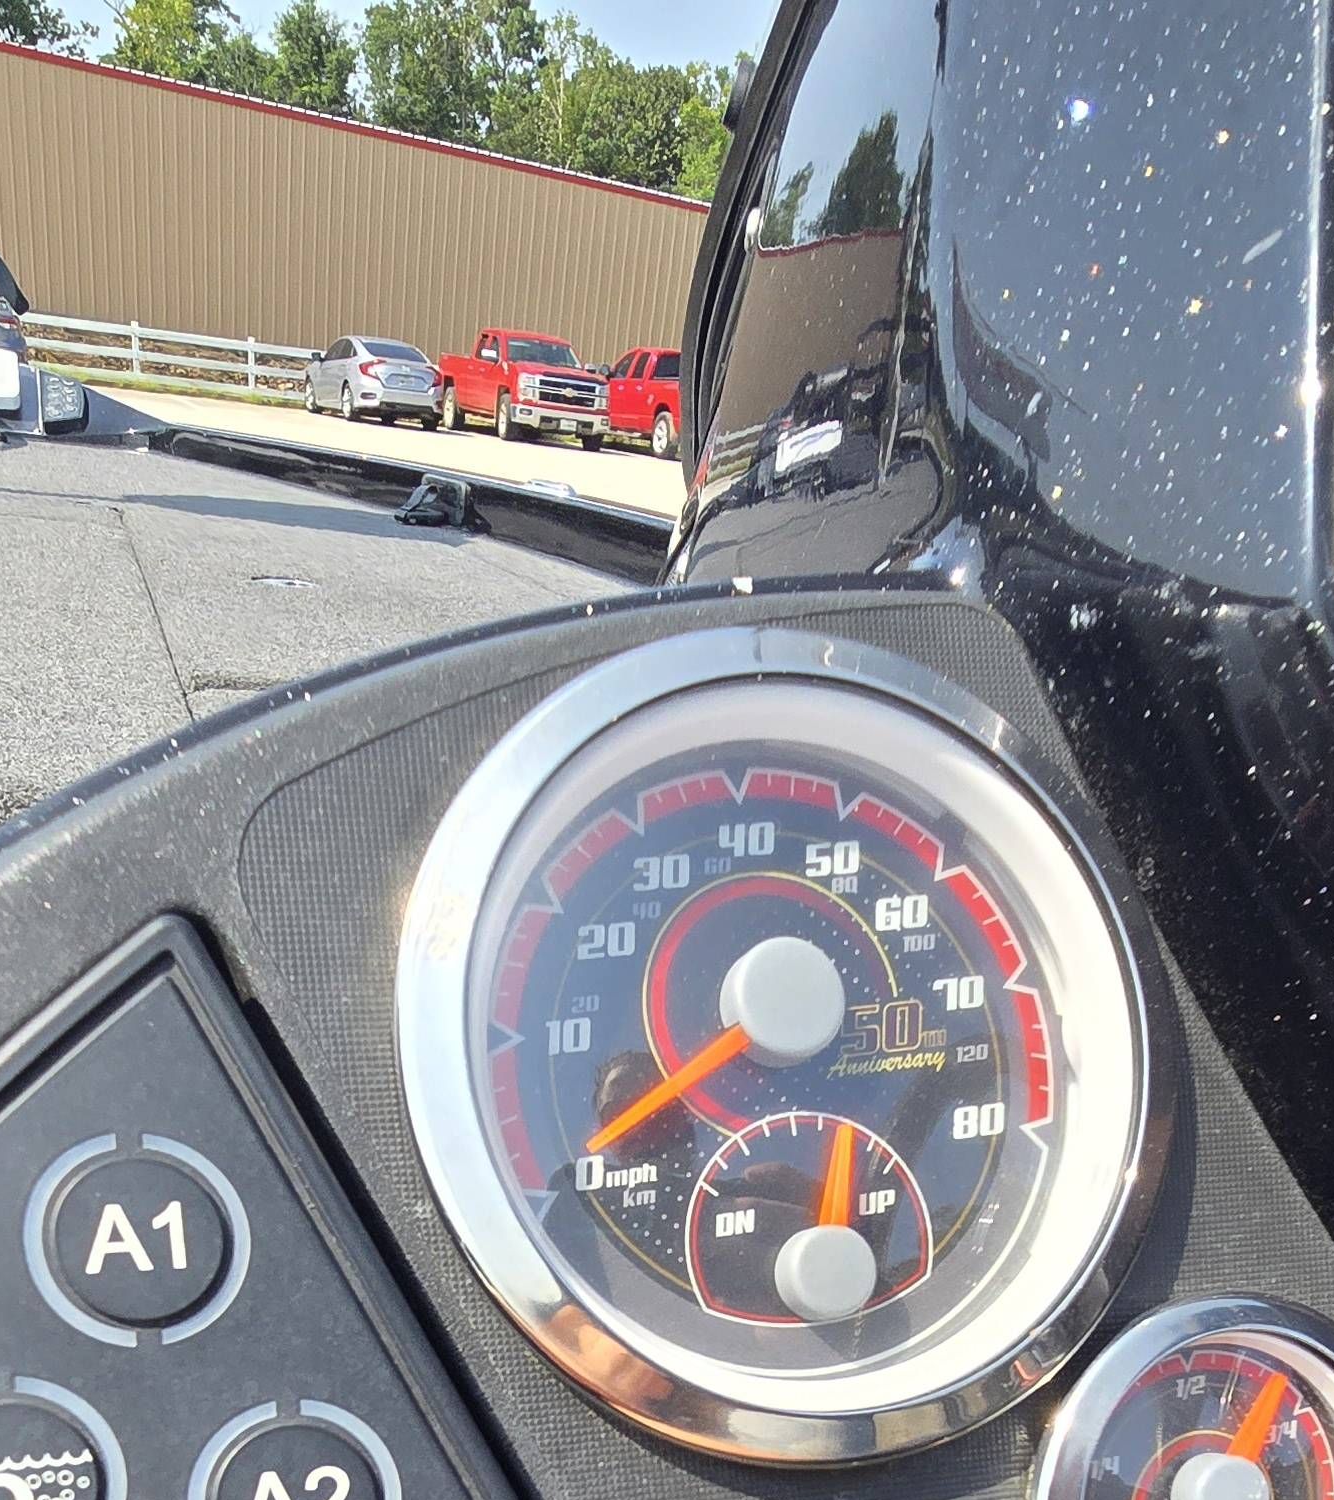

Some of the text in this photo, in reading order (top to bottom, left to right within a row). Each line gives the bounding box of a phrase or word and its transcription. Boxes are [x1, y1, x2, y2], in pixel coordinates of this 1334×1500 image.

[718, 821, 775, 857] 40
[633, 854, 689, 891] 30
[703, 856, 731, 874] 60
[805, 840, 860, 877] 50
[831, 876, 858, 894] 80
[632, 901, 661, 919] 40
[874, 894, 928, 932] 60
[577, 922, 635, 960] 20
[902, 934, 935, 952] 100
[572, 995, 600, 1014] 20
[932, 976, 985, 1011] 70
[545, 1017, 591, 1056] 10
[827, 1050, 947, 1079] Anniversary
[955, 1044, 989, 1063] 120
[953, 1102, 1005, 1139] 80
[623, 1188, 657, 1208] km
[859, 1189, 896, 1216] UP
[85, 1200, 188, 1275] A1
[716, 1209, 755, 1238] DN
[1175, 1375, 1206, 1400] 1/2
[1264, 1420, 1298, 1445] 3/4
